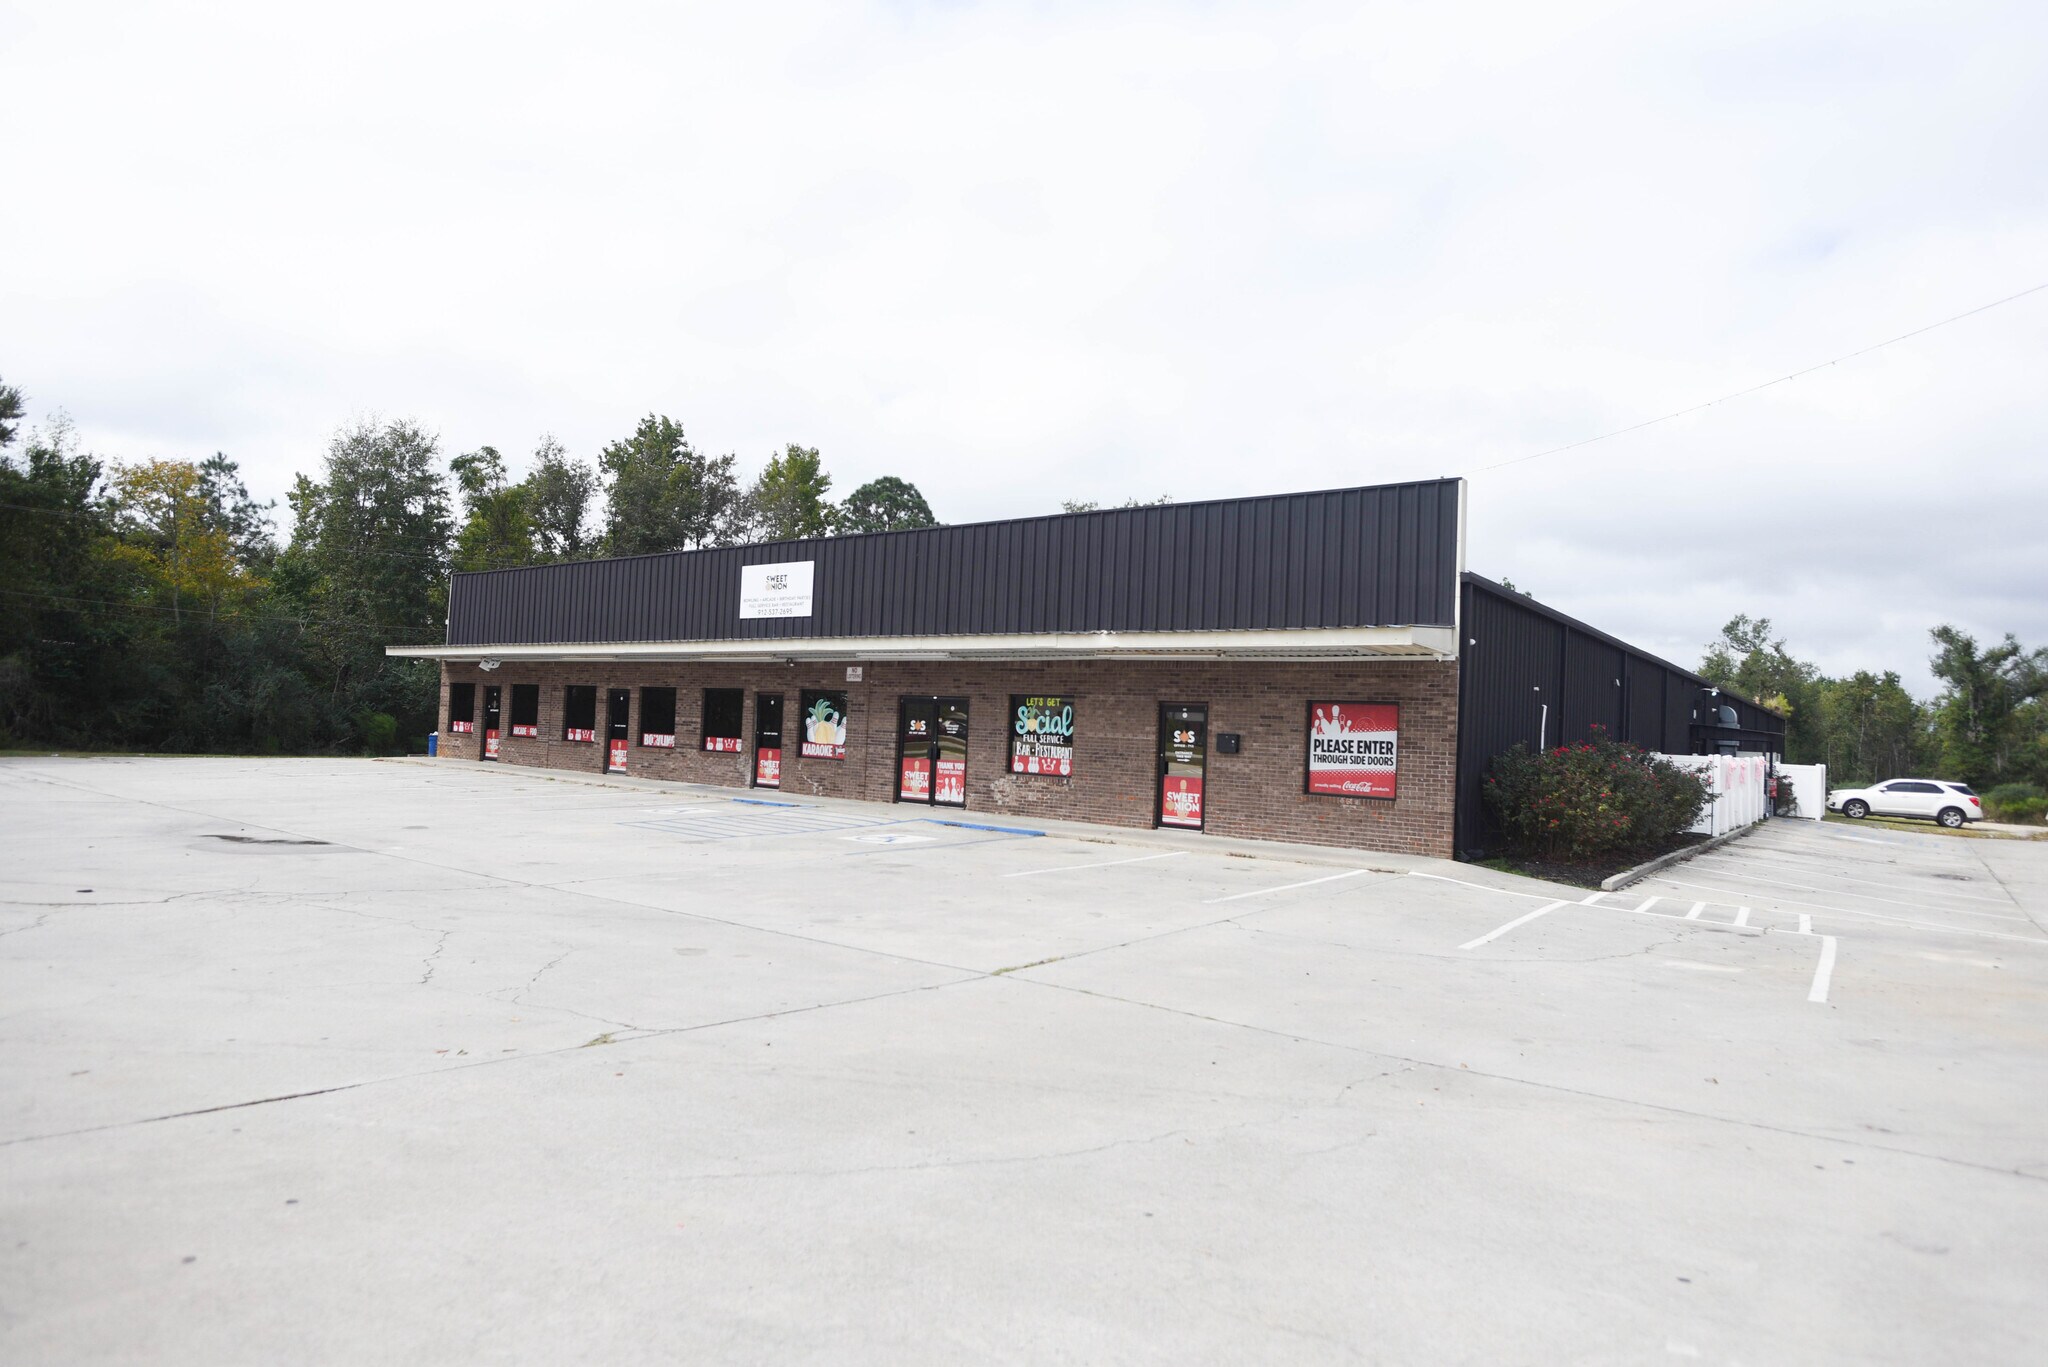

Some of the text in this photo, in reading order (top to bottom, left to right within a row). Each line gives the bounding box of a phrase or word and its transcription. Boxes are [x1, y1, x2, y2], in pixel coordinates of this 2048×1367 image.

[766, 574, 788, 583] SWEET
[1026, 697, 1060, 706] LET'S GET
[1022, 734, 1064, 744] FULL SERVICE
[802, 743, 833, 757] KARAOKE
[1314, 739, 1394, 755] PLEASE ENTER
[760, 760, 780, 769] SWEET
[1313, 754, 1394, 766] THROUGH SIDE DOORS
[954, 762, 965, 770] YOU
[905, 771, 929, 780] SWEET
[1166, 791, 1200, 804] SWEET
